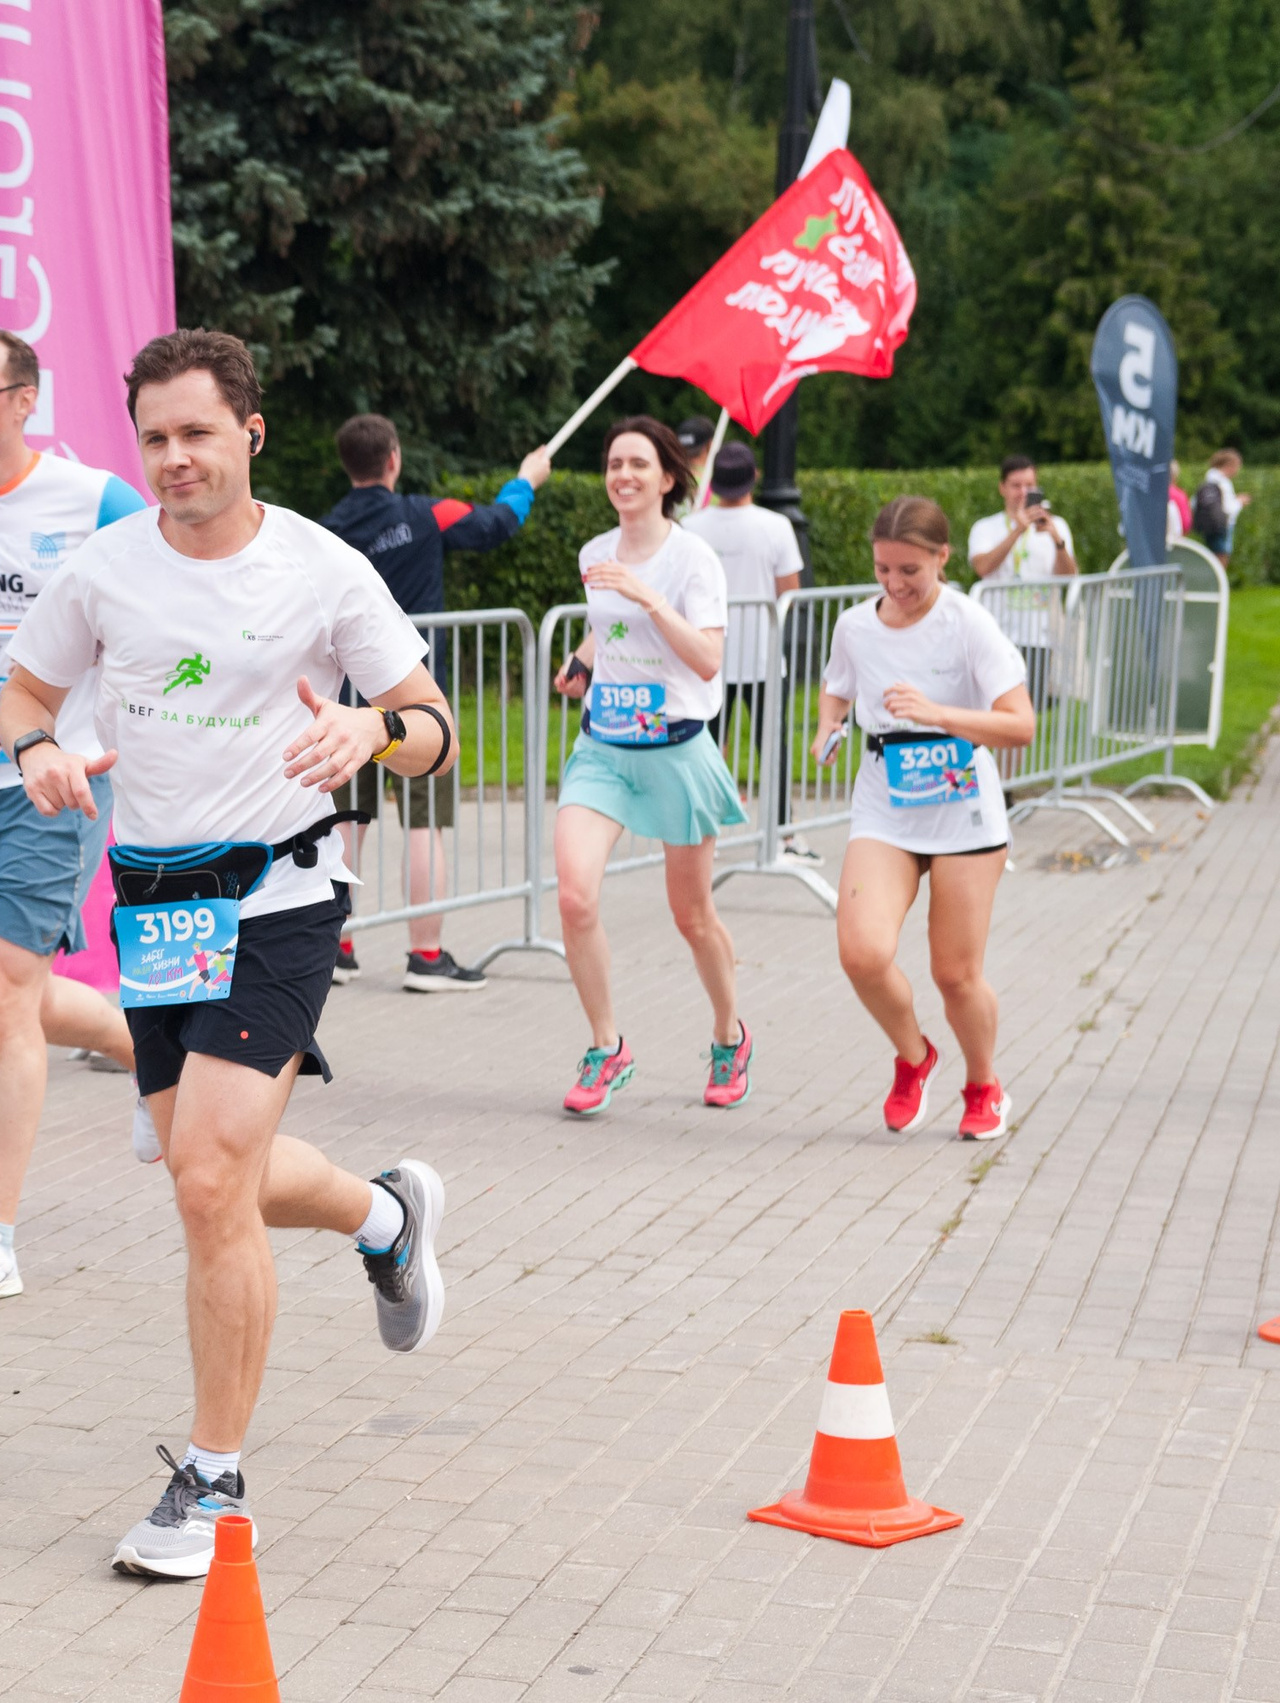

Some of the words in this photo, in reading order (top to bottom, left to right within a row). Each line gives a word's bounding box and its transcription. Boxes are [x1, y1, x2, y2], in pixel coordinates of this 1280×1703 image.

[600, 686, 651, 708] 3198
[160, 711, 179, 723] ЗА
[186, 714, 261, 729] БУДУЩЕЕ
[899, 742, 959, 770] 3201
[136, 907, 215, 944] 3199
